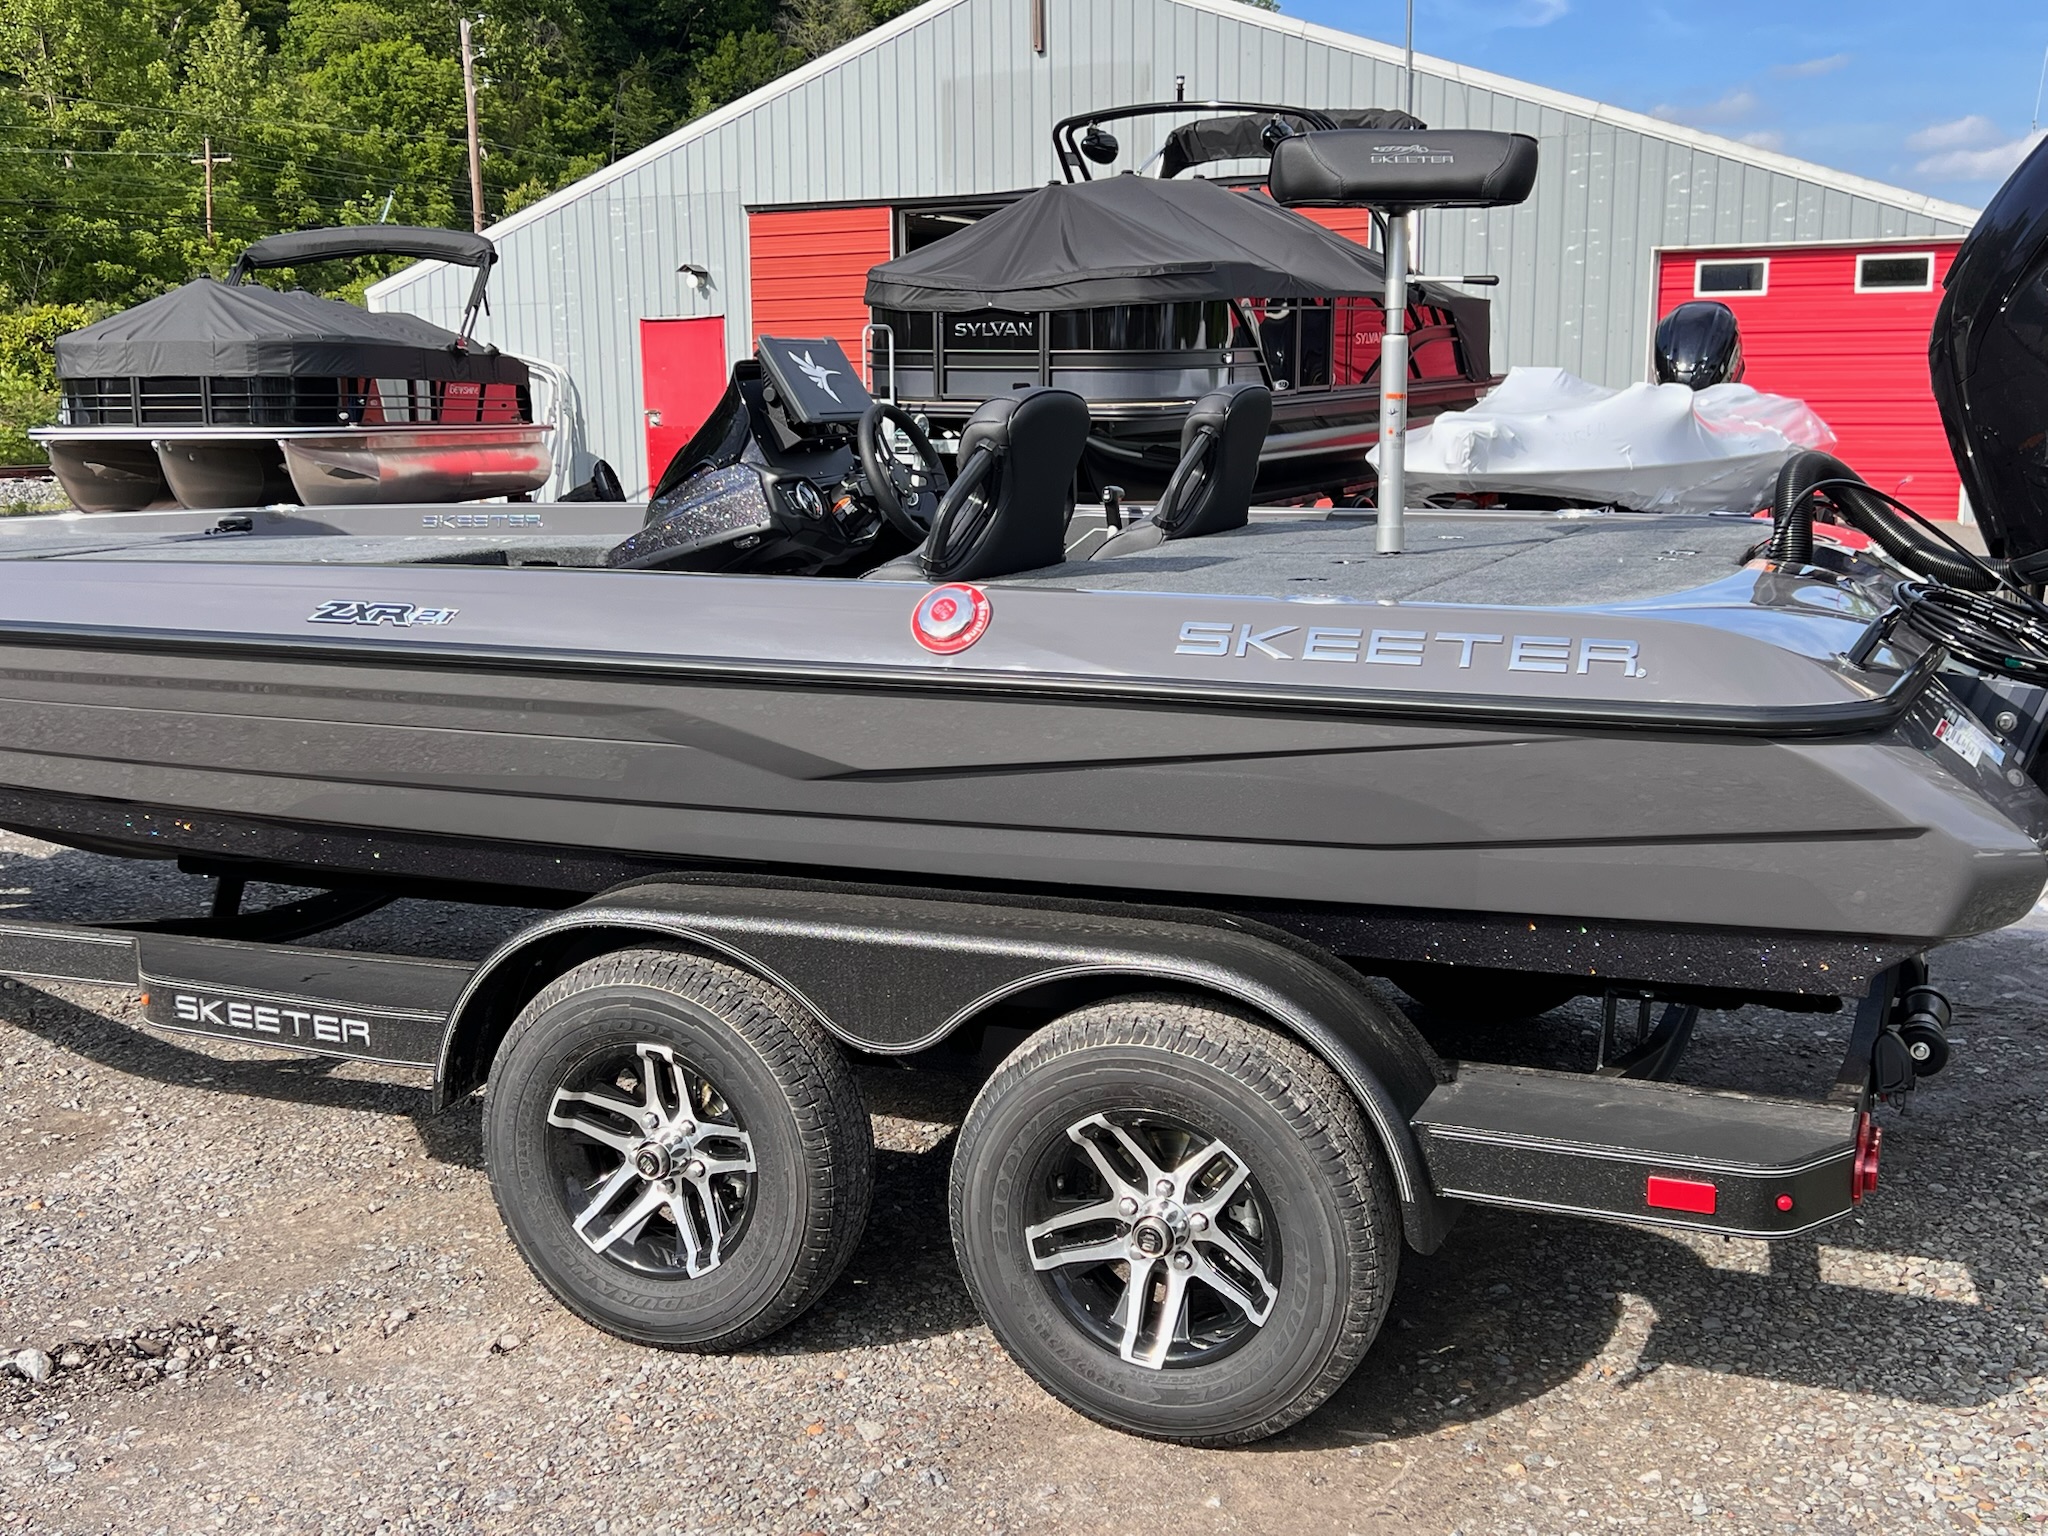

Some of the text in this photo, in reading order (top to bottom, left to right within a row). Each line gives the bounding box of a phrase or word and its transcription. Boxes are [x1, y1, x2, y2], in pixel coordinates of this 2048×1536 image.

[1370, 155, 1454, 164] SKEETER
[954, 321, 1033, 337] SYLVAN
[422, 514, 541, 529] SKEETER
[962, 599, 989, 642] Warning
[1173, 620, 1640, 678] SKEETER
[173, 994, 371, 1049] SKEETER
[993, 1086, 1103, 1256] GOODYEAR
[1183, 1226, 1311, 1405] ENDURANCE
